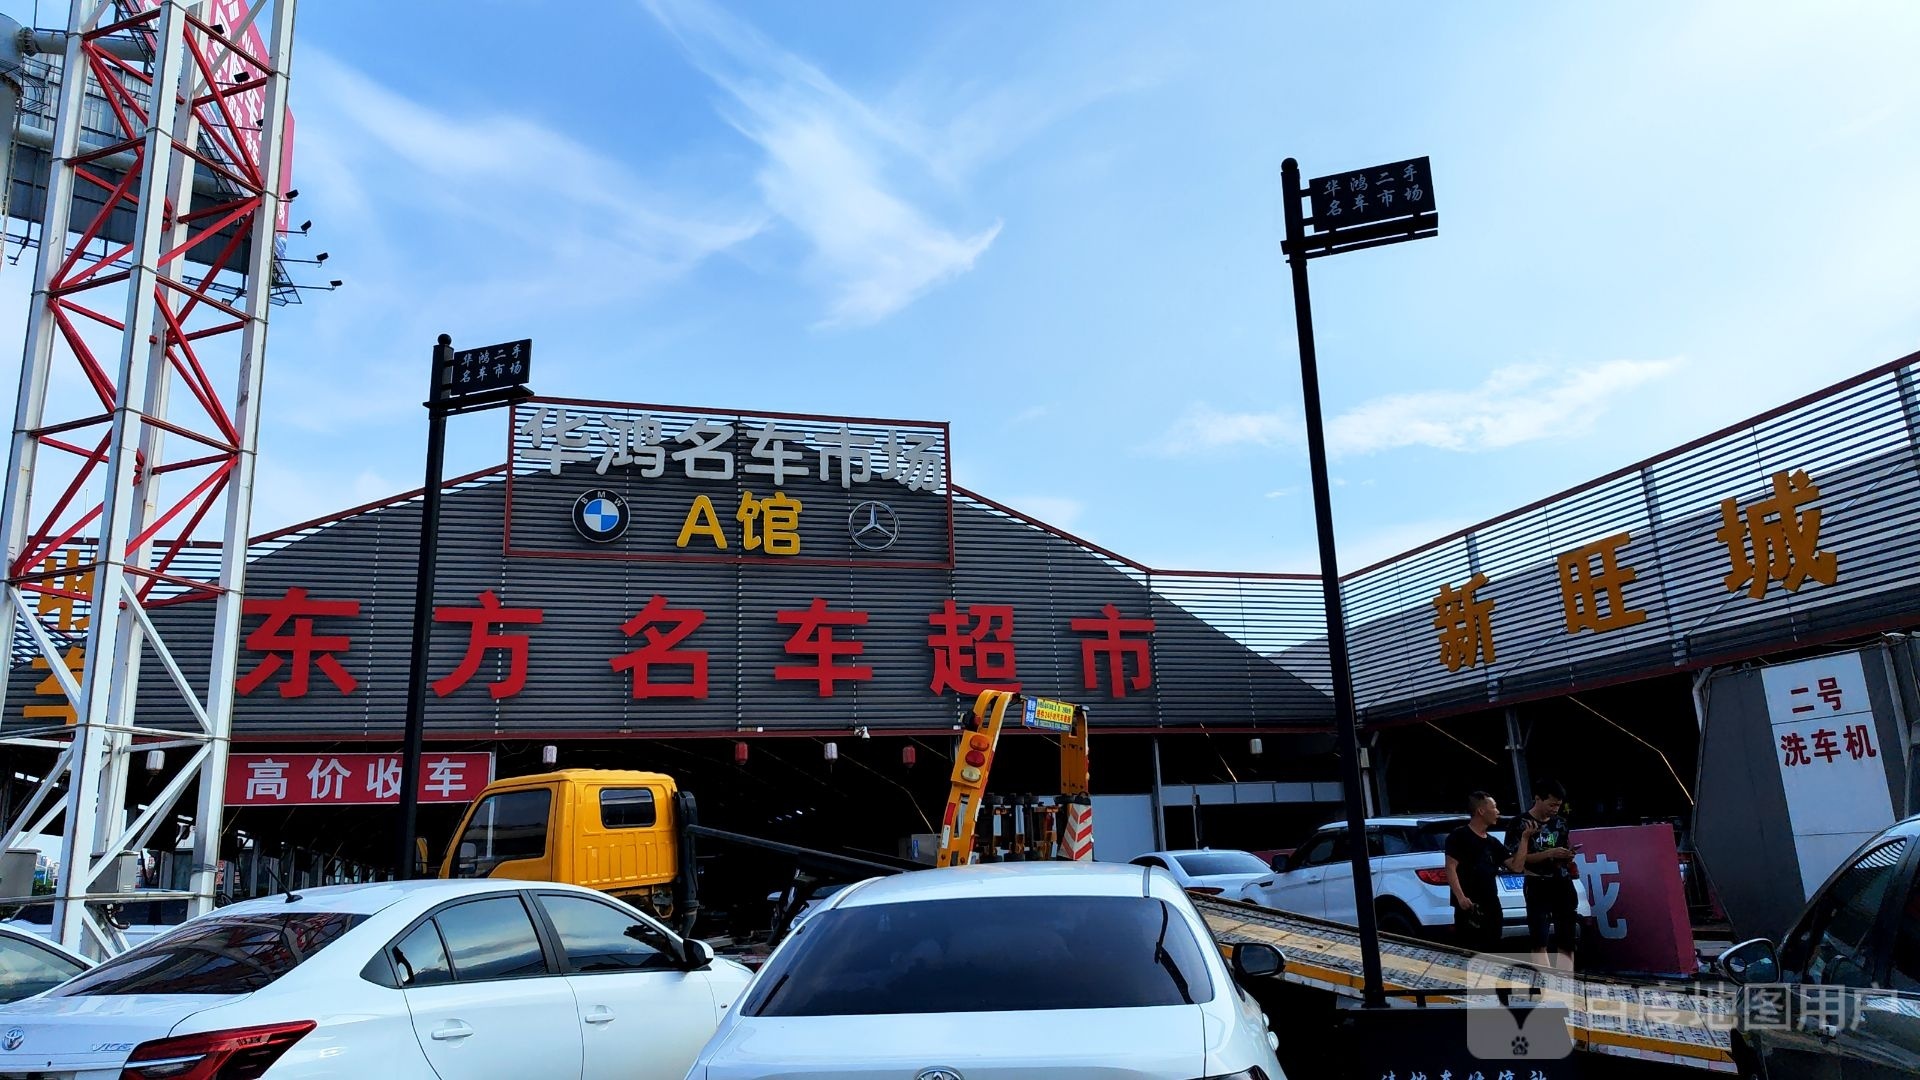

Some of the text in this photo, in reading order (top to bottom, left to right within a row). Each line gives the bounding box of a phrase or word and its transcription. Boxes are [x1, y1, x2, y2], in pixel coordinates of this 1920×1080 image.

[1323, 163, 1418, 197] 华鸿二手
[1326, 183, 1424, 217] 名车市场
[460, 360, 523, 383] 名车市场
[461, 344, 523, 367] 华鸿二手
[519, 407, 943, 492] 华鸿名车市场
[580, 491, 624, 507] BMW
[676, 491, 803, 555] A馆
[1432, 468, 1839, 673] 新旺城
[236, 587, 1155, 699] 东方名车超市
[1790, 677, 1843, 714] 二号
[1780, 724, 1877, 767] 洗车机
[246, 758, 467, 800] 高价收车
